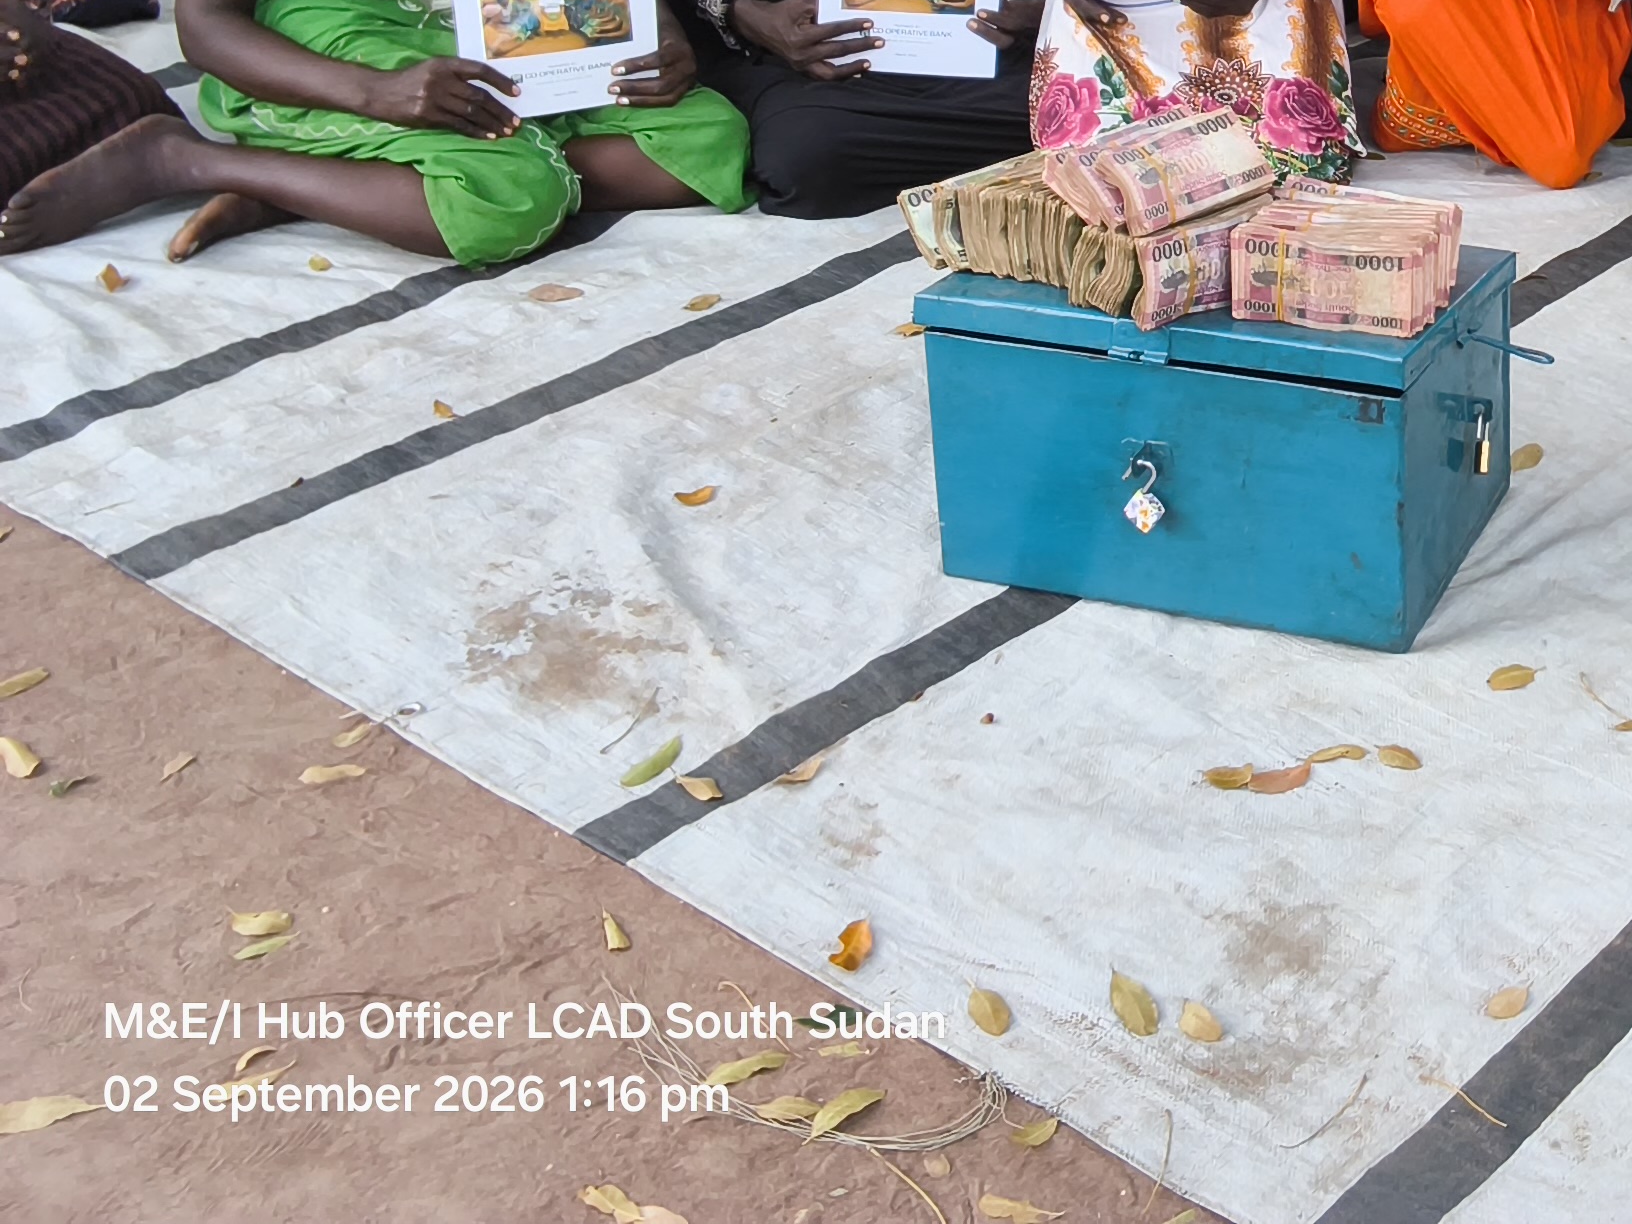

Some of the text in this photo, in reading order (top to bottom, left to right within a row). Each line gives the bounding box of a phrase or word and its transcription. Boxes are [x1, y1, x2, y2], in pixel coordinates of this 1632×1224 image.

[1198, 114, 1235, 136] 1000
[1113, 146, 1154, 165] 1000
[1242, 165, 1268, 182] 1000
[1144, 201, 1169, 220] 1000
[1355, 256, 1405, 272] 1000
[1151, 303, 1178, 322] 1000
[1244, 300, 1276, 313] 1000
[1372, 316, 1403, 329] 1000
